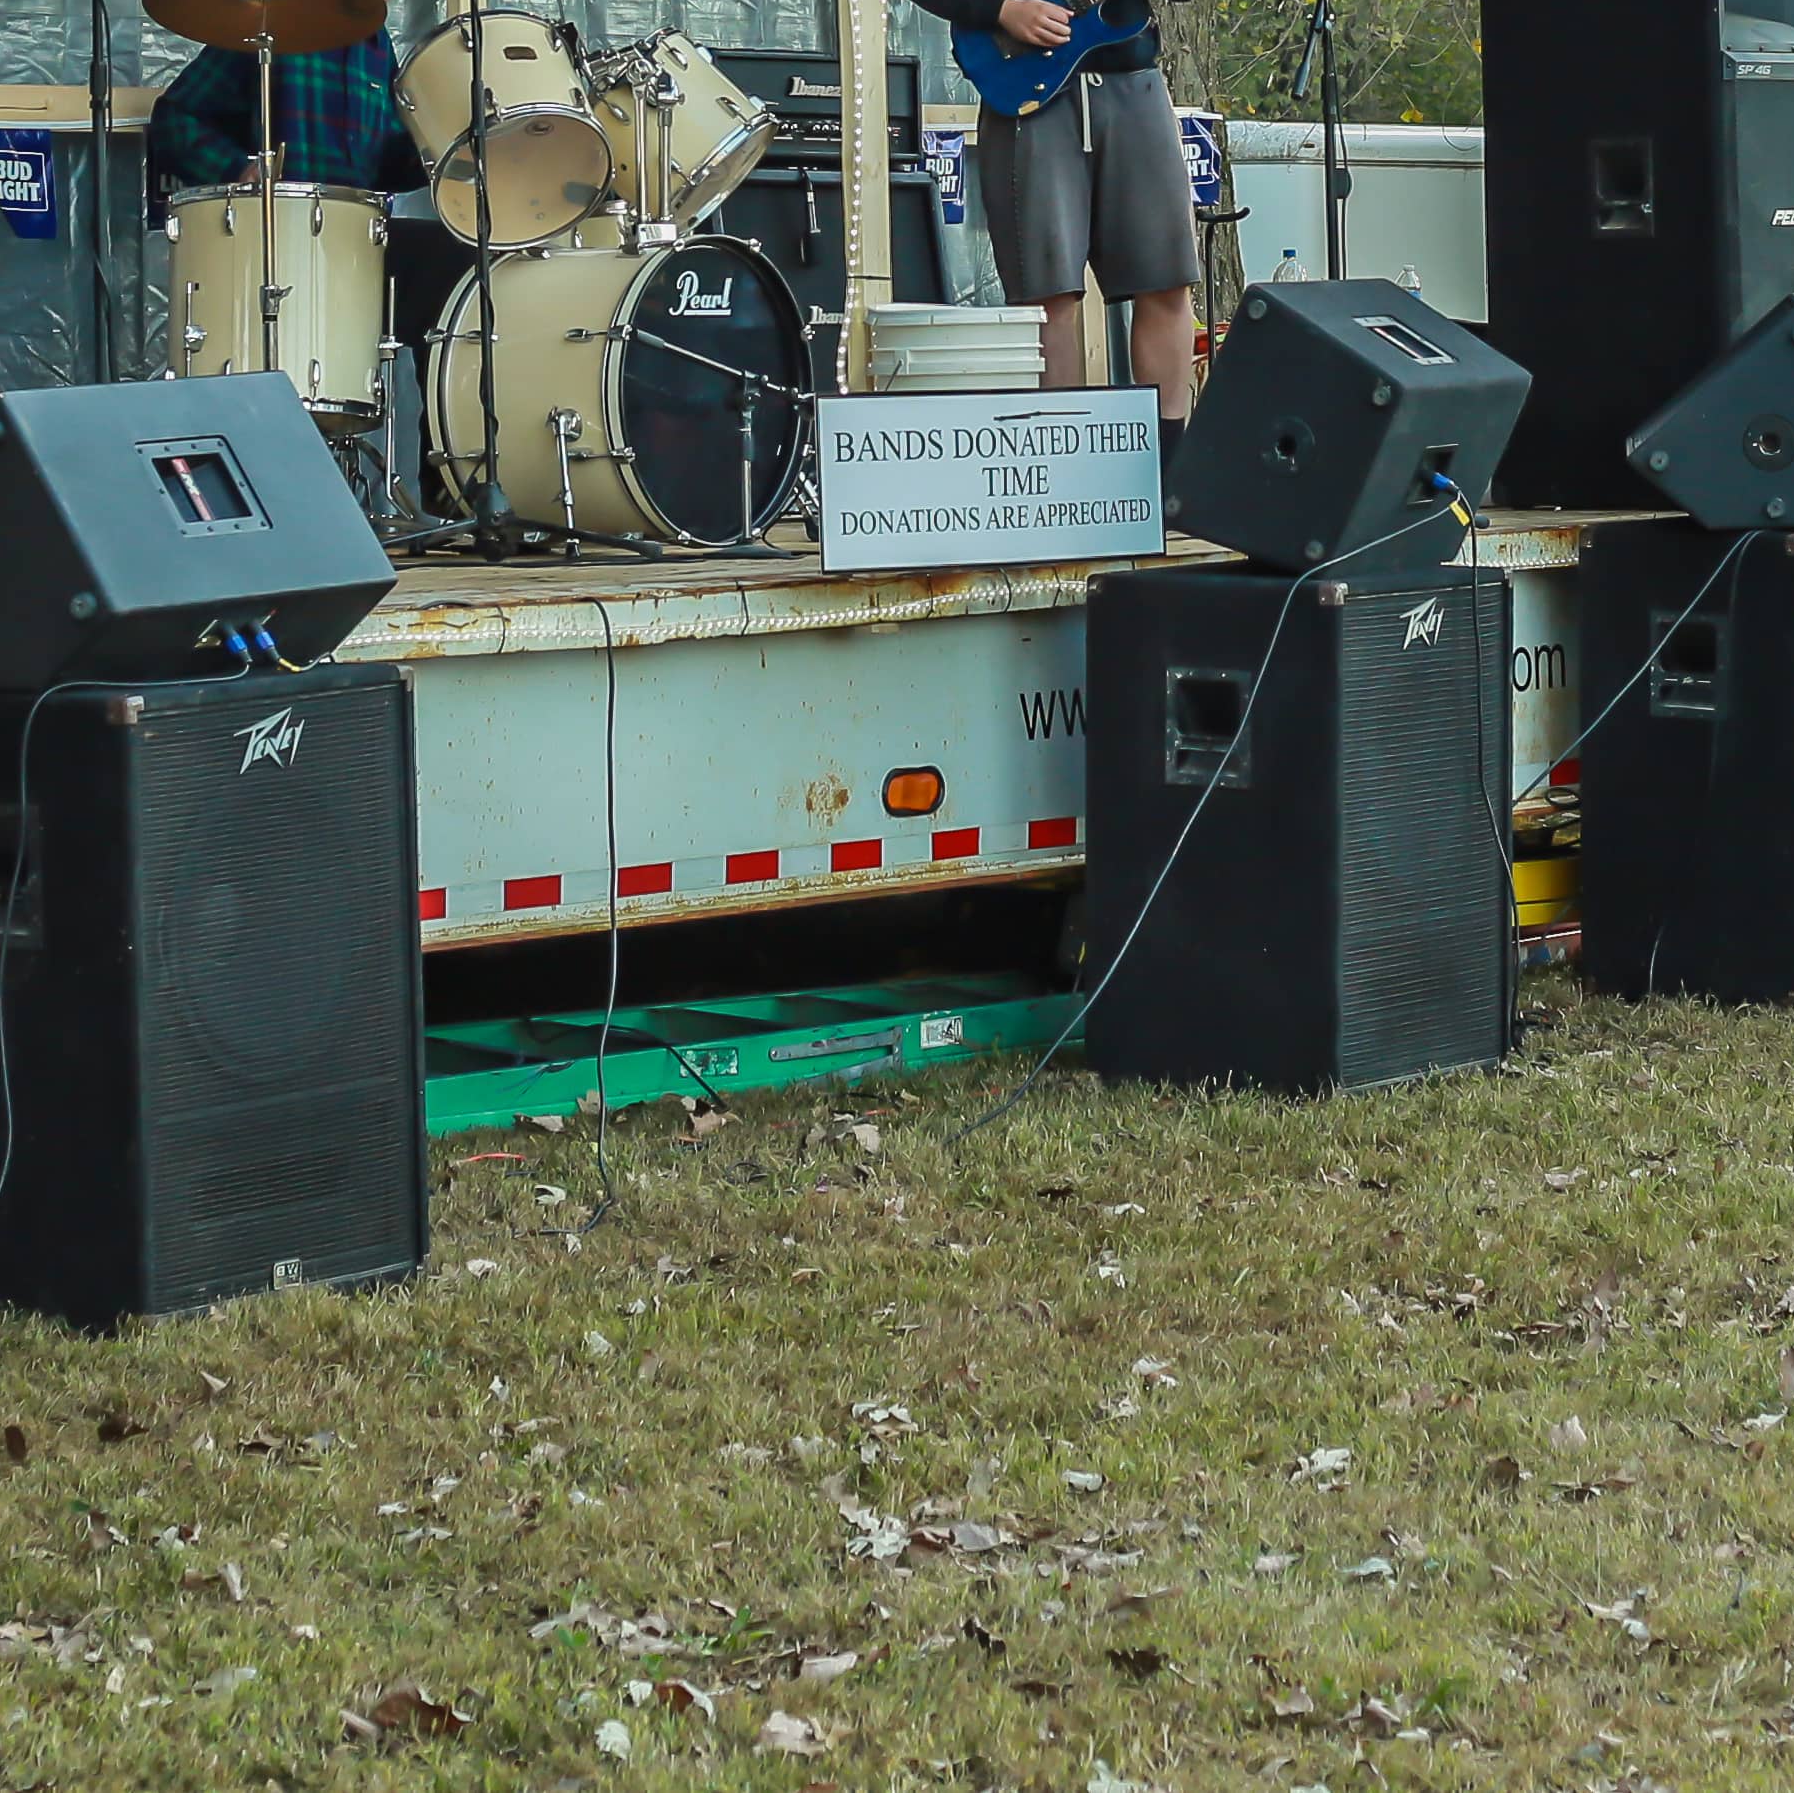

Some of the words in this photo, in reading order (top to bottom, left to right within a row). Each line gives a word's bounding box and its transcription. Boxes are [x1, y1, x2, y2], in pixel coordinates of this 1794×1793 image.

[789, 77, 842, 97] Ibanez
[669, 271, 733, 316] Pearl
[809, 306, 845, 325] Iban
[834, 428, 944, 463] BANDS
[953, 425, 1080, 460] DONATED
[1085, 421, 1150, 454] THEIR
[982, 465, 1050, 497] TIME
[840, 506, 980, 536] DONATIONS
[986, 504, 1030, 530] ARE
[1034, 498, 1152, 527] APPRECIATED
